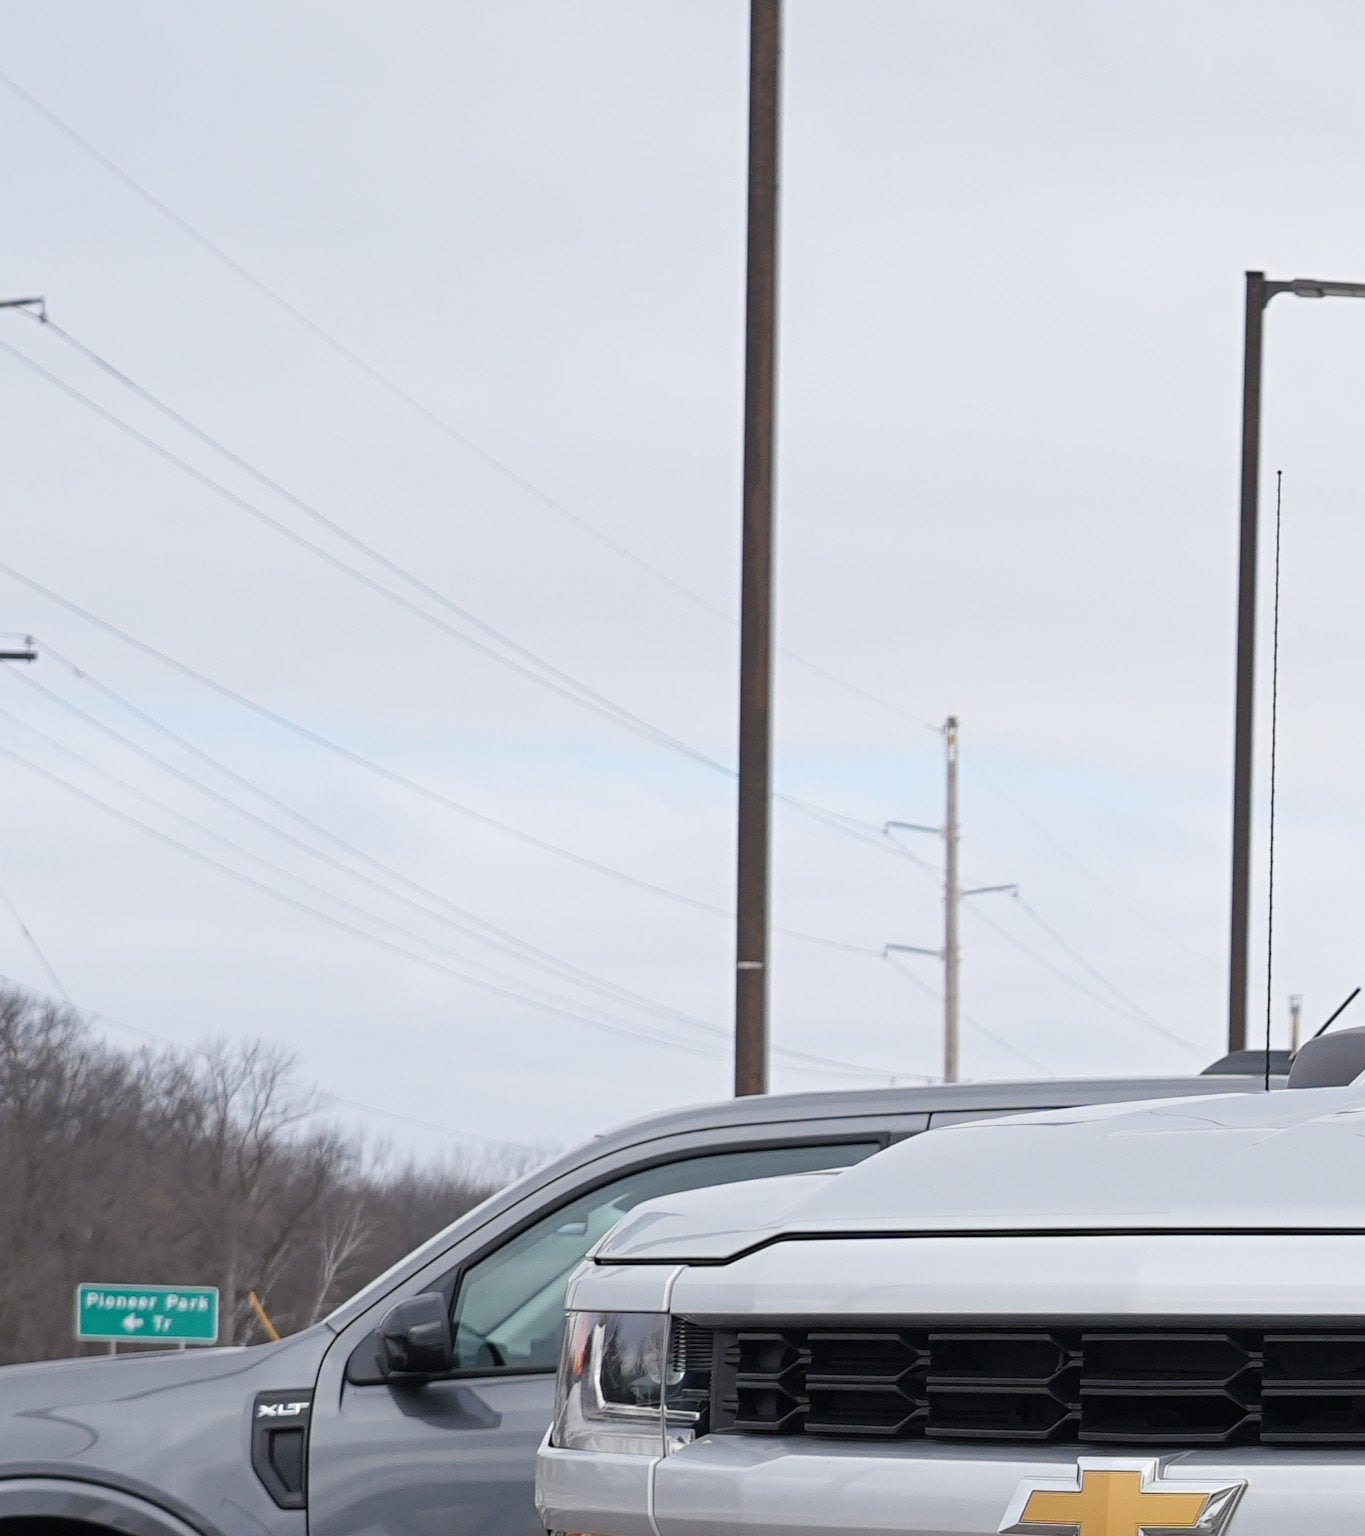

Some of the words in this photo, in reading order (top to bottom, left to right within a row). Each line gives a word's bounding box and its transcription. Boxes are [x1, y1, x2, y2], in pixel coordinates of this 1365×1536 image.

[86, 1291, 158, 1310] Pioneer
[166, 1293, 209, 1312] Park
[153, 1314, 173, 1332] Tr
[256, 1401, 311, 1419] XLT
